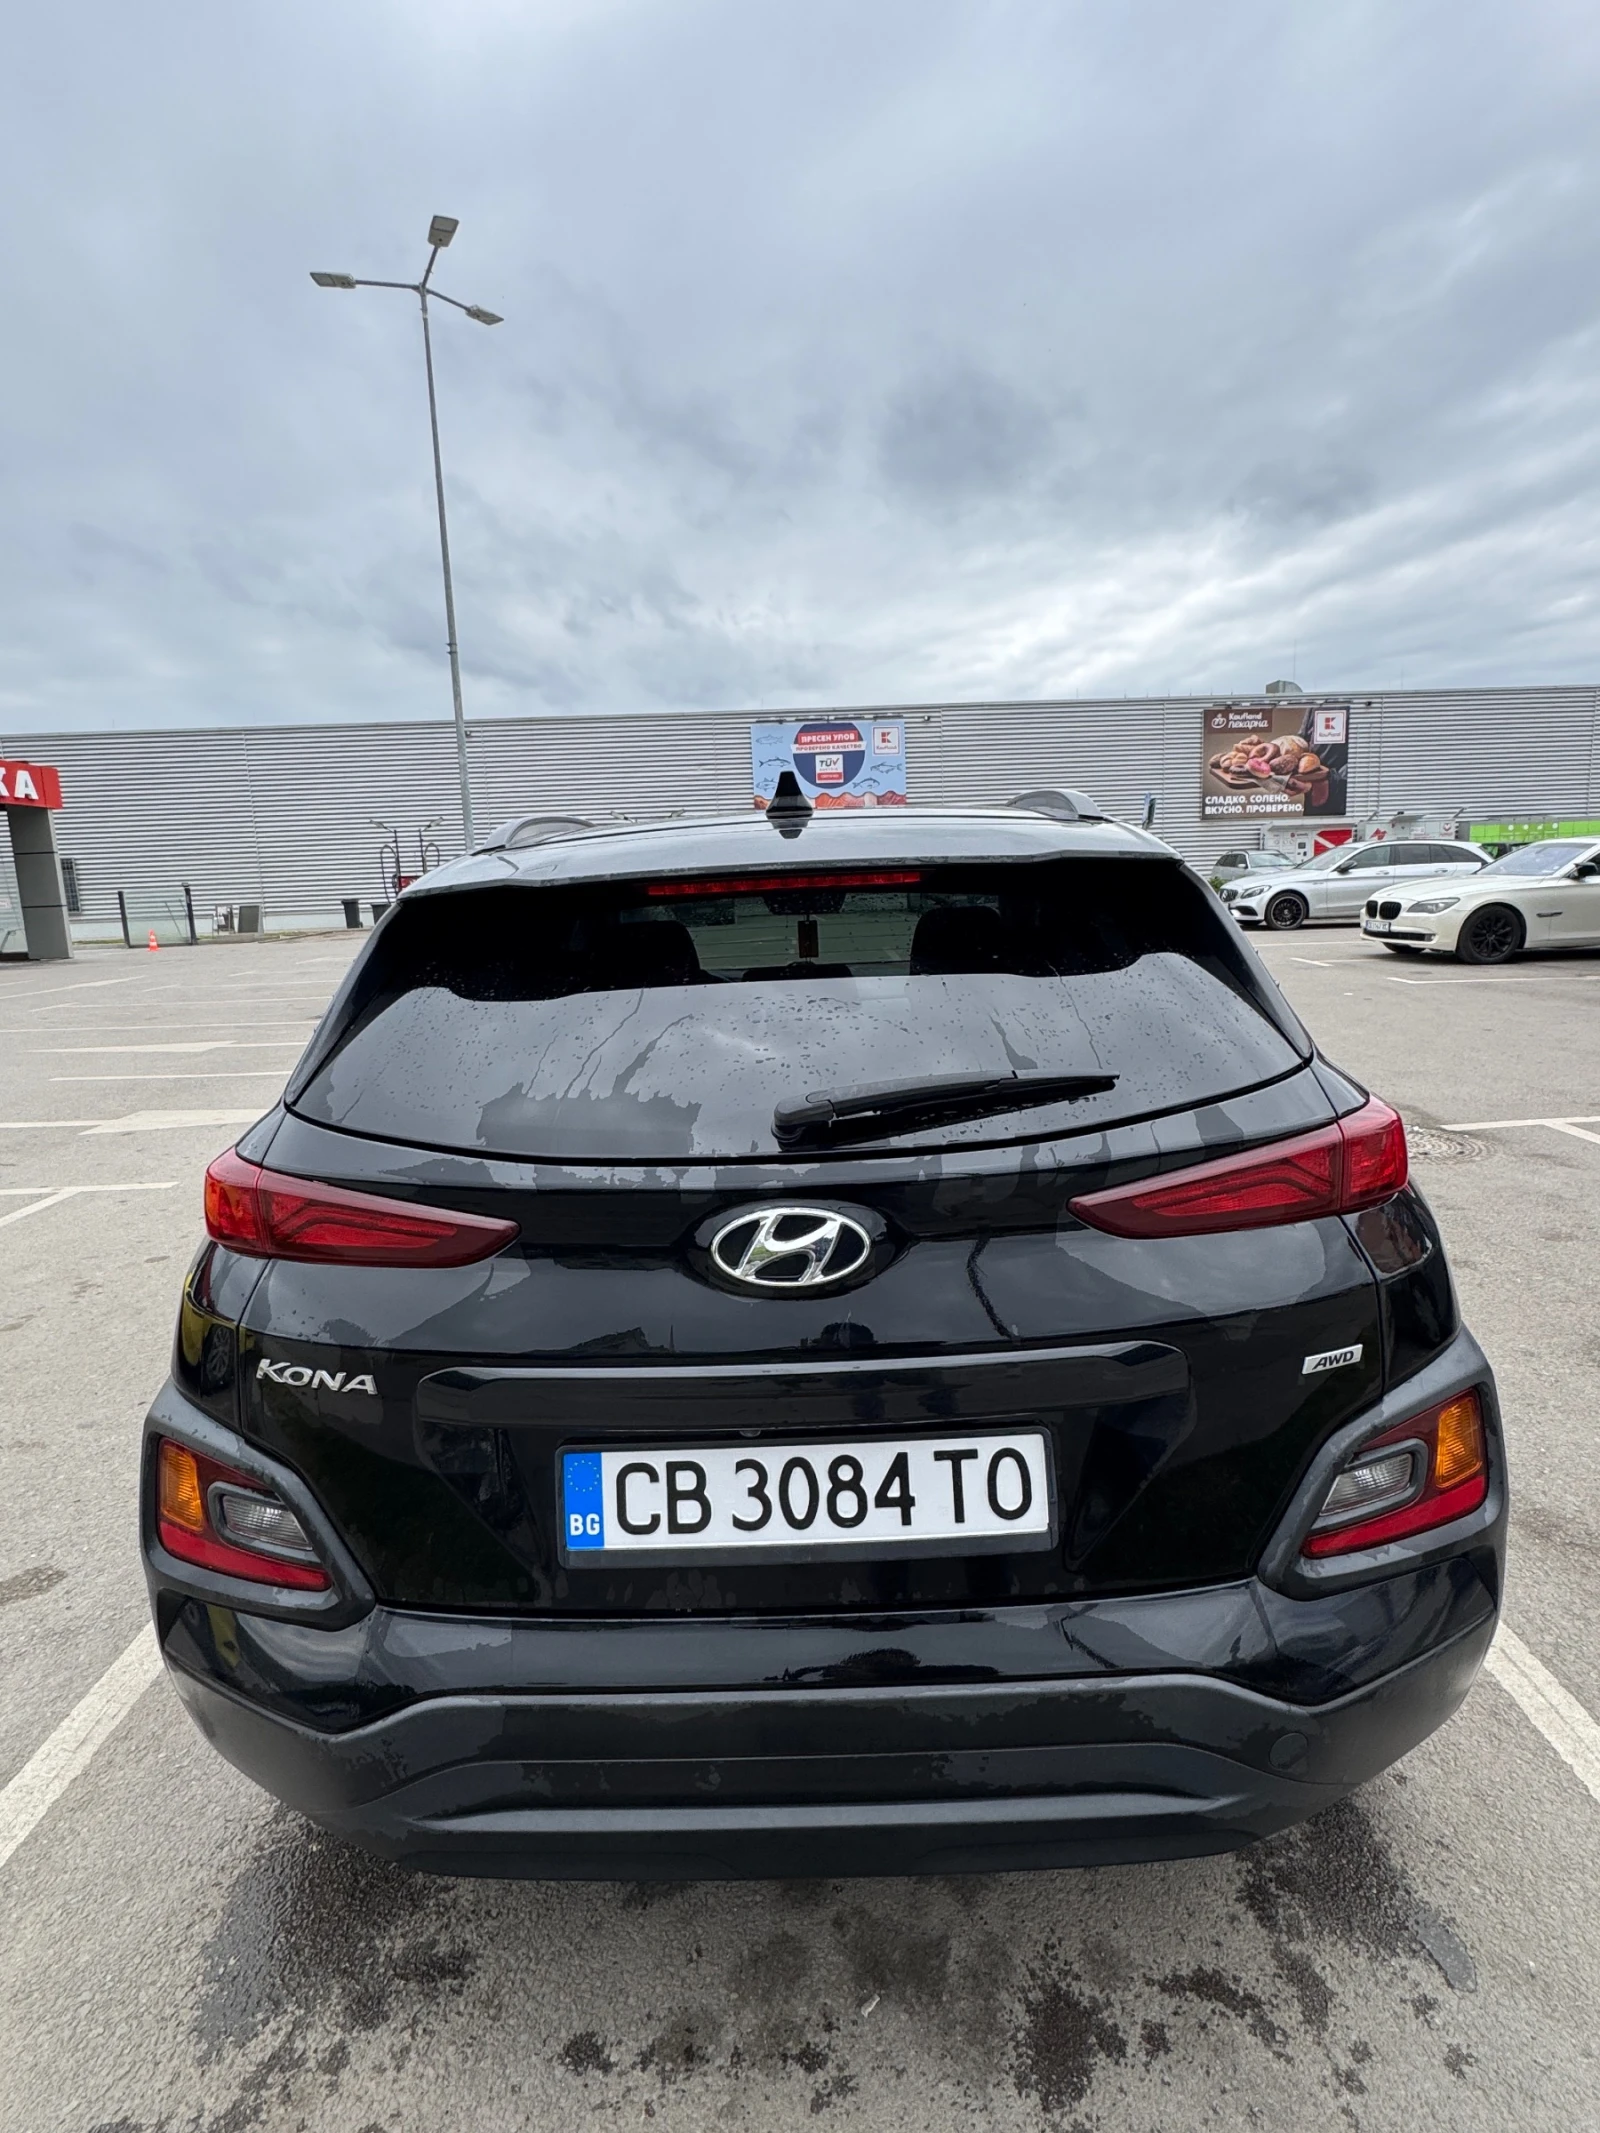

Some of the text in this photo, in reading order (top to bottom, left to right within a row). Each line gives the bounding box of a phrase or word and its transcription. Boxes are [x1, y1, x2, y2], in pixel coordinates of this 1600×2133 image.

[1229, 712, 1262, 720] Kaufland
[801, 734, 832, 743] ПРЕСЕН
[819, 757, 840, 767] TÜV
[1205, 794, 1291, 805] СЛАДКО. СОЛЕНО.
[1205, 803, 1304, 815] ВКУСНО. ПРОВЕРЕНО.
[1312, 1350, 1354, 1371] AWD
[256, 1358, 378, 1395] KONA
[731, 1453, 916, 1531] 3084
[569, 1513, 600, 1536] BG
